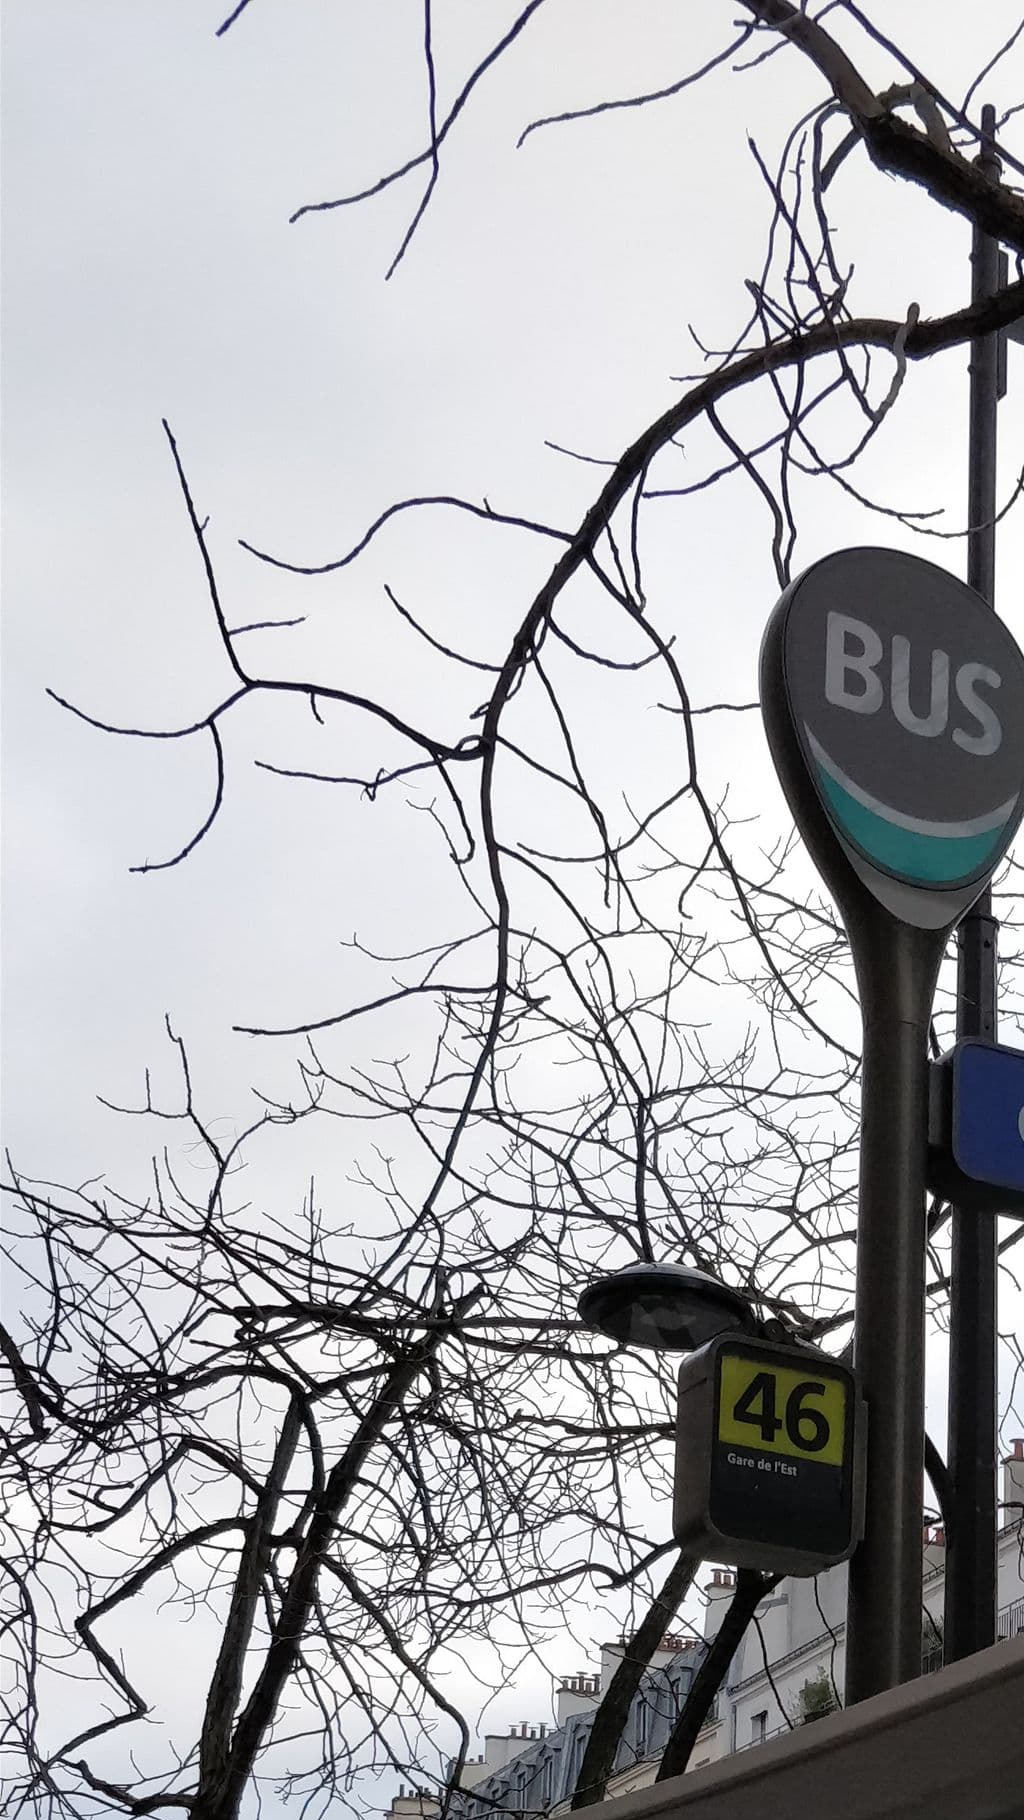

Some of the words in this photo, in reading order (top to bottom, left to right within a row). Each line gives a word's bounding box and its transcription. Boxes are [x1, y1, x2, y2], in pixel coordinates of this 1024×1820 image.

[825, 611, 1002, 756] BUS
[733, 1372, 830, 1452] 46
[727, 1452, 755, 1468] Gare
[757, 1458, 772, 1471] de
[774, 1460, 798, 1477] l'Est
